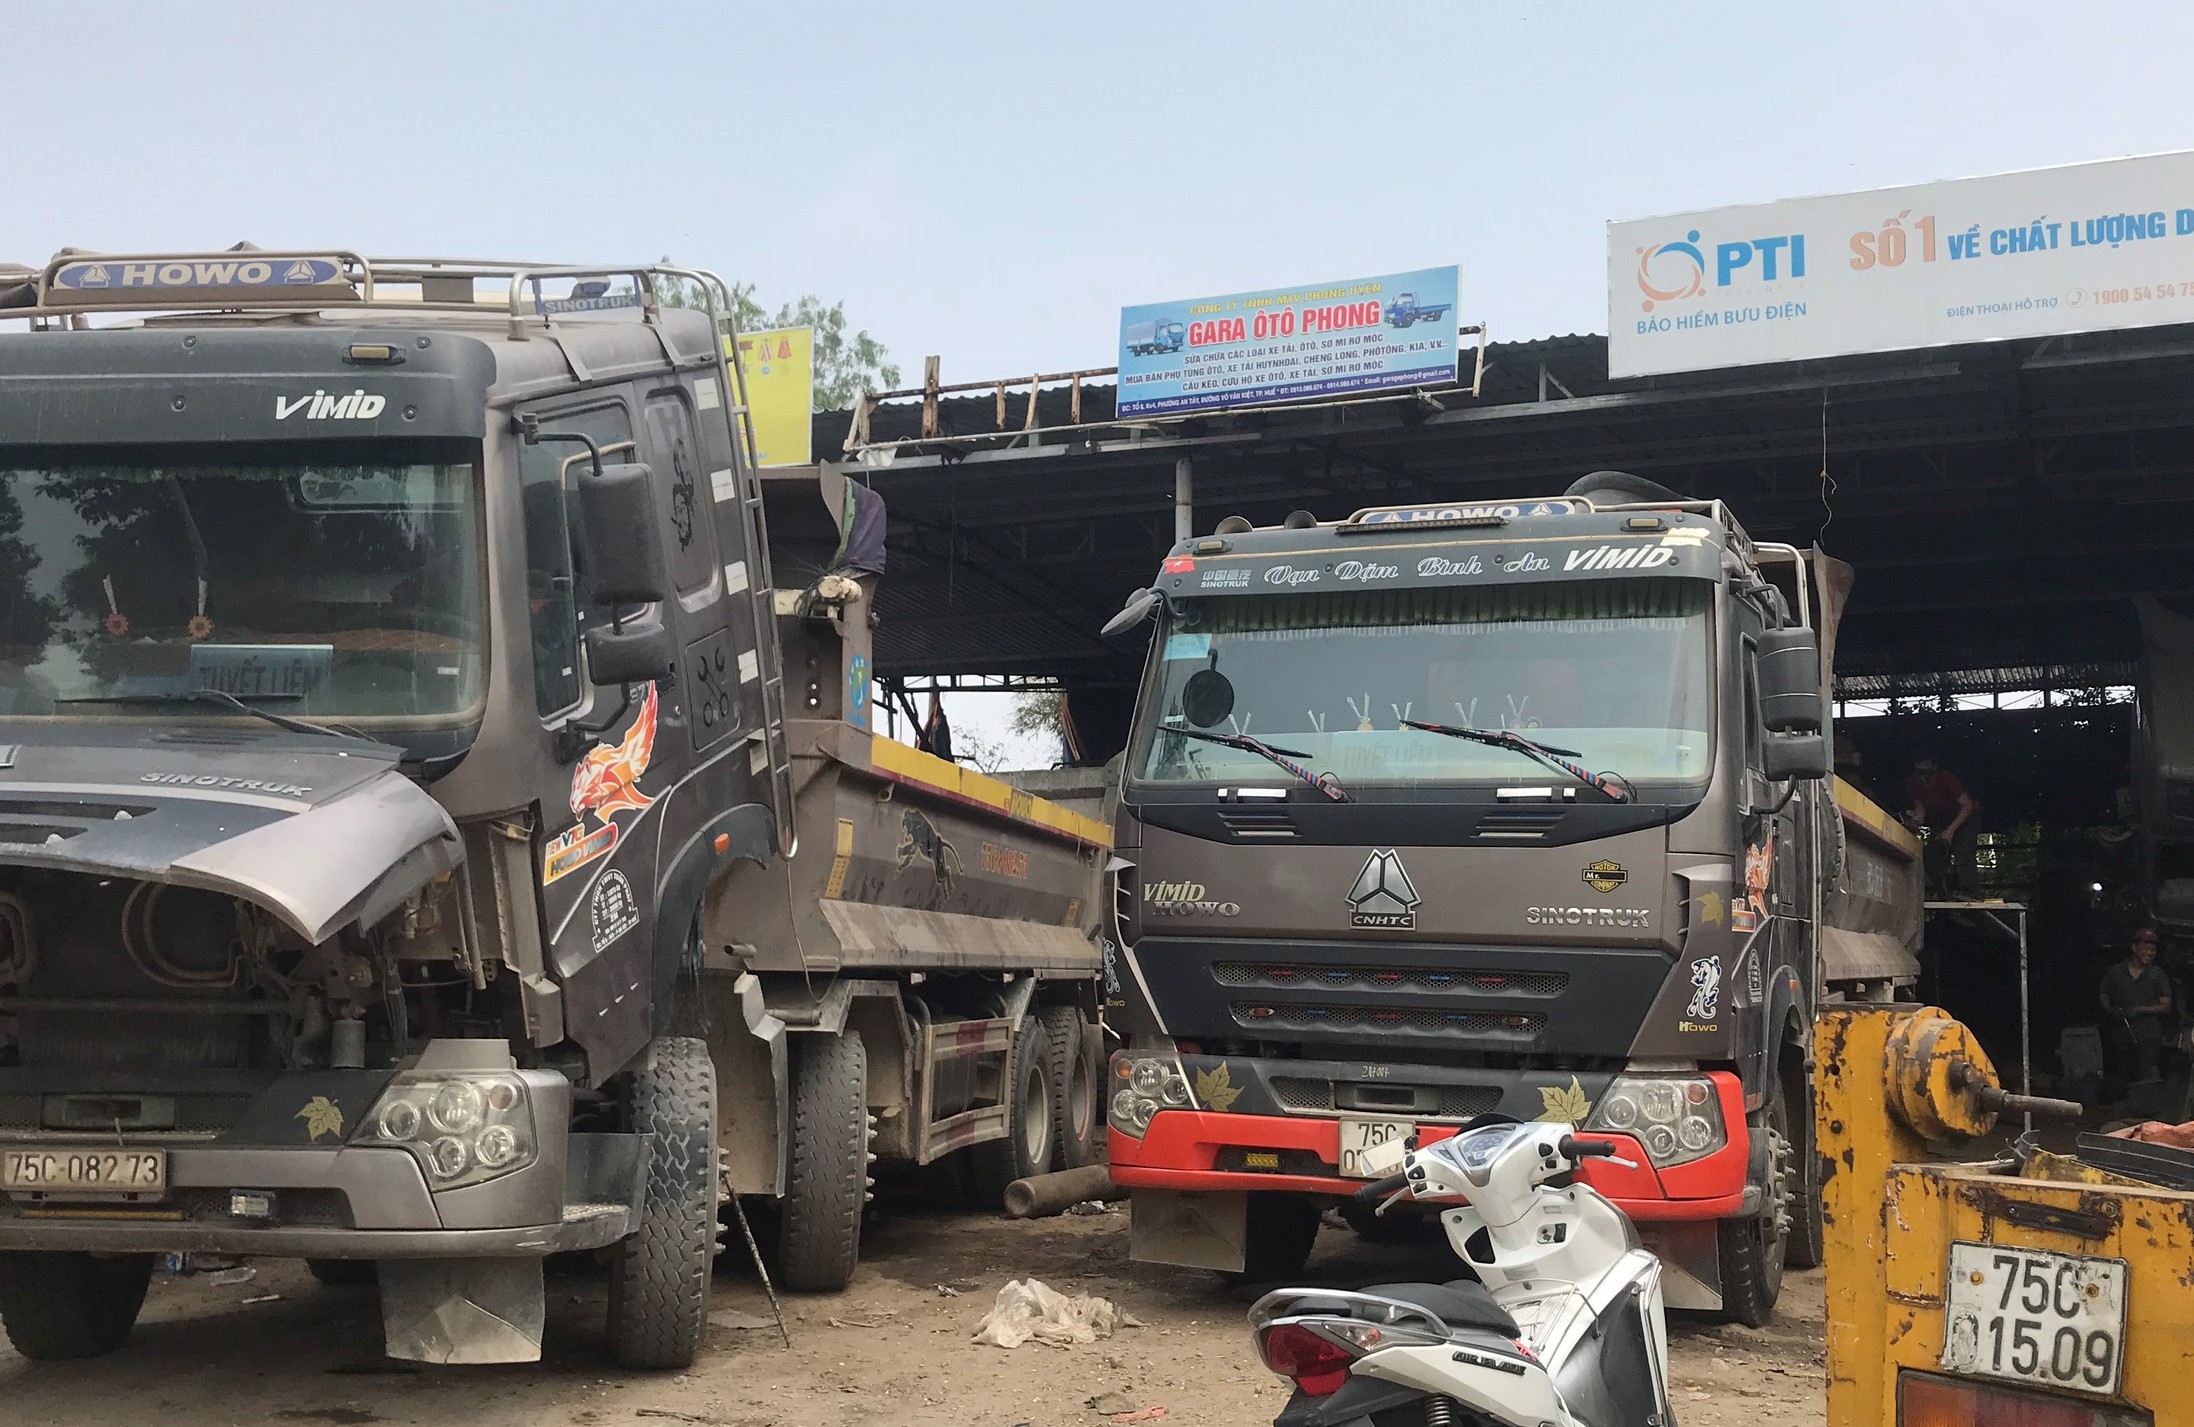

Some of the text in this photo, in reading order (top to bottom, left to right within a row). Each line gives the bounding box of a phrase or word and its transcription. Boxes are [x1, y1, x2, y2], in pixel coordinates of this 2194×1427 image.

[1849, 209, 1912, 271] SỐ
[1915, 215, 1936, 263] 1
[1947, 223, 1981, 260] VỀ
[1990, 215, 2062, 256] CHẤT
[2070, 211, 2166, 249] LƯỢNG
[1717, 234, 1805, 286] PTI
[122, 263, 272, 286] HOWO
[544, 297, 633, 313] SINOTRUK
[1242, 297, 1273, 309] TNHH
[1277, 295, 1301, 304] MTV
[1304, 288, 1346, 301] PHONG
[1947, 304, 1974, 318] ĐIỆN
[1977, 301, 2012, 315] THOẠI
[2035, 296, 2058, 308] TRỢ
[2094, 289, 2129, 305] 1900
[2134, 287, 2152, 301] 54
[2157, 284, 2175, 298] 54
[1189, 301, 1380, 347] GARA ÔTÔ PHONG
[1637, 301, 1807, 334] BẢO HIỂM BƯU ĐIỆN
[1228, 348, 1244, 360] CÁC
[1247, 347, 1266, 358] LOẠI
[1268, 346, 1278, 355] XE
[1300, 341, 1318, 351] ÔTÔ,
[1321, 339, 1333, 349] SƠ
[1335, 338, 1346, 346] MI
[1125, 375, 1143, 385] MUA
[1146, 371, 1162, 382] BÁN
[1165, 370, 1181, 380] PHỤ
[1207, 365, 1225, 375] ÔTÔ,
[1228, 364, 1238, 372] XE
[1304, 353, 1332, 364] CHENG
[1335, 350, 1360, 361] LONG,
[1409, 342, 1427, 351] KIA,
[1241, 374, 1252, 385] HỘ
[1255, 374, 1266, 383] XE
[1268, 371, 1286, 382] ÔTÔ,
[1289, 370, 1300, 378] XE
[1321, 366, 1333, 375] SƠ
[1335, 365, 1346, 373] MI
[1264, 552, 1551, 587] Vạn Dặm Bình An
[1200, 580, 1249, 588] SINOTRUK
[140, 773, 312, 797] SINOTRUK
[1593, 863, 1616, 871] MOTOR
[1153, 900, 1241, 918] HOWO
[1352, 915, 1411, 926] CNHTC
[1526, 906, 1649, 927] SINOTRUK
[1358, 1123, 1397, 1147] 75C
[1993, 1254, 2081, 1319] 75C
[1452, 1350, 1527, 1376] AIR BLADE
